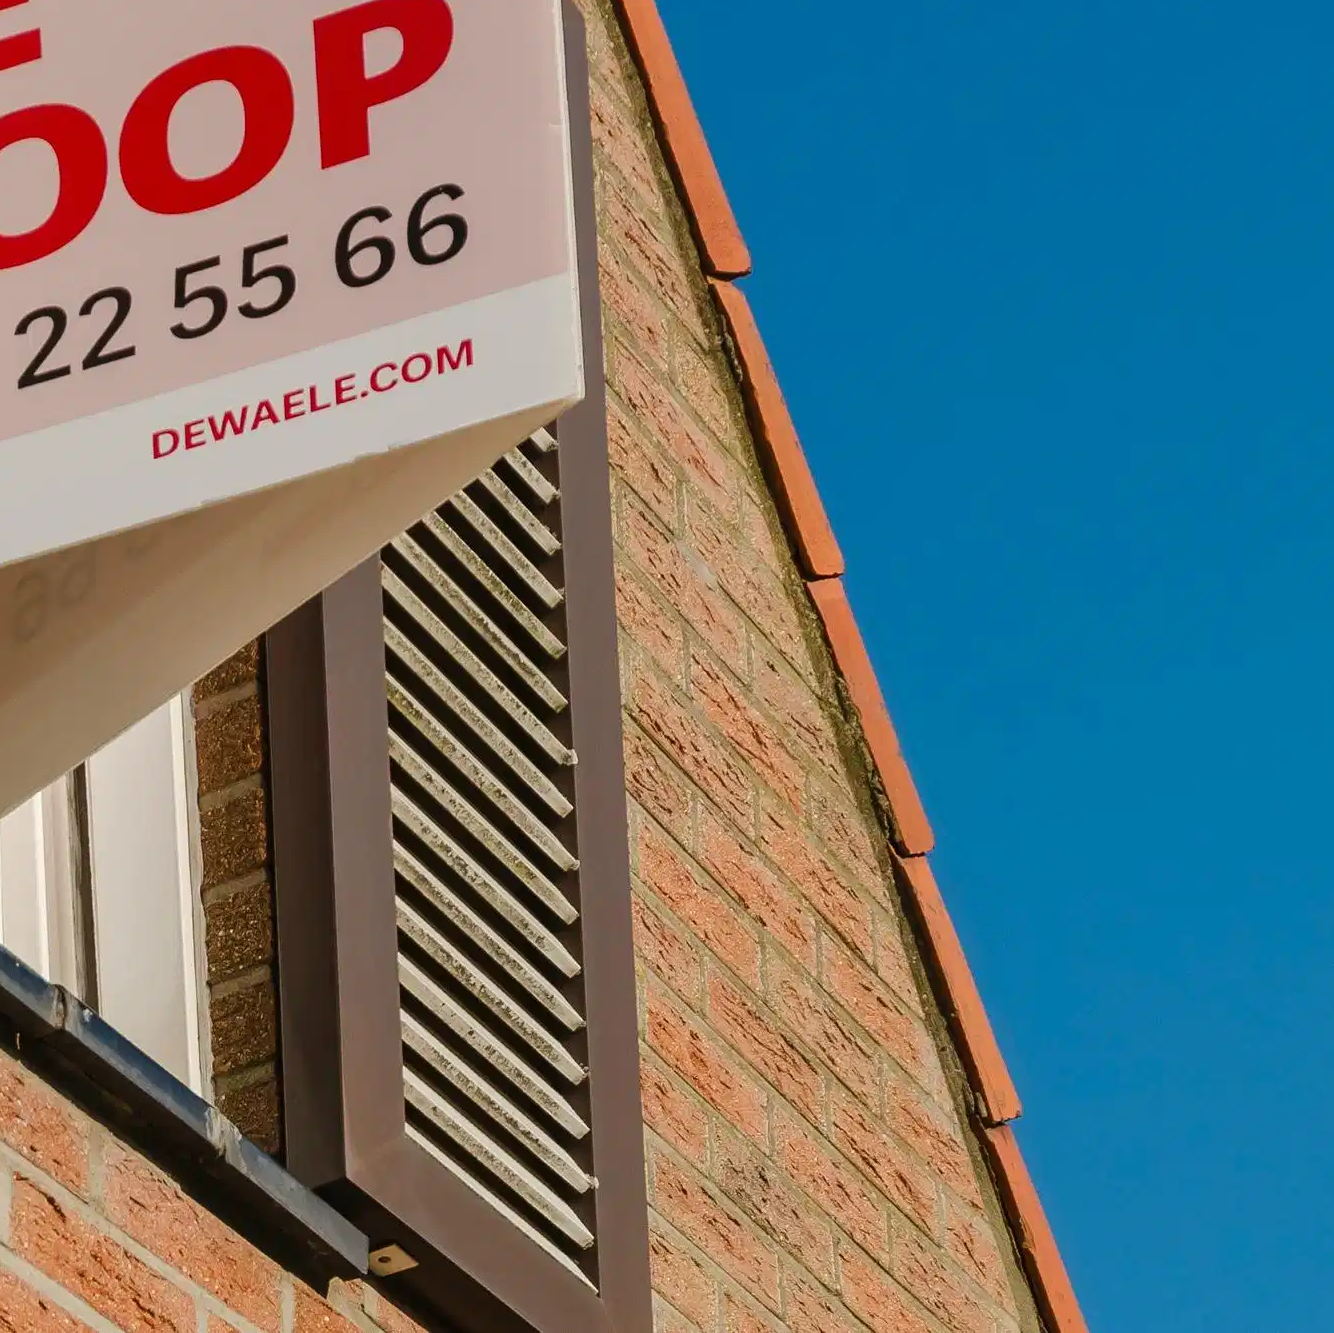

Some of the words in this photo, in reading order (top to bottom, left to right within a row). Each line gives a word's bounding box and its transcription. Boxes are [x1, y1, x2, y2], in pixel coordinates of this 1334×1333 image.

[13, 286, 137, 390] 22
[169, 234, 297, 340] 55
[333, 182, 470, 289] 66
[151, 337, 475, 460] DEWAELE.COM
